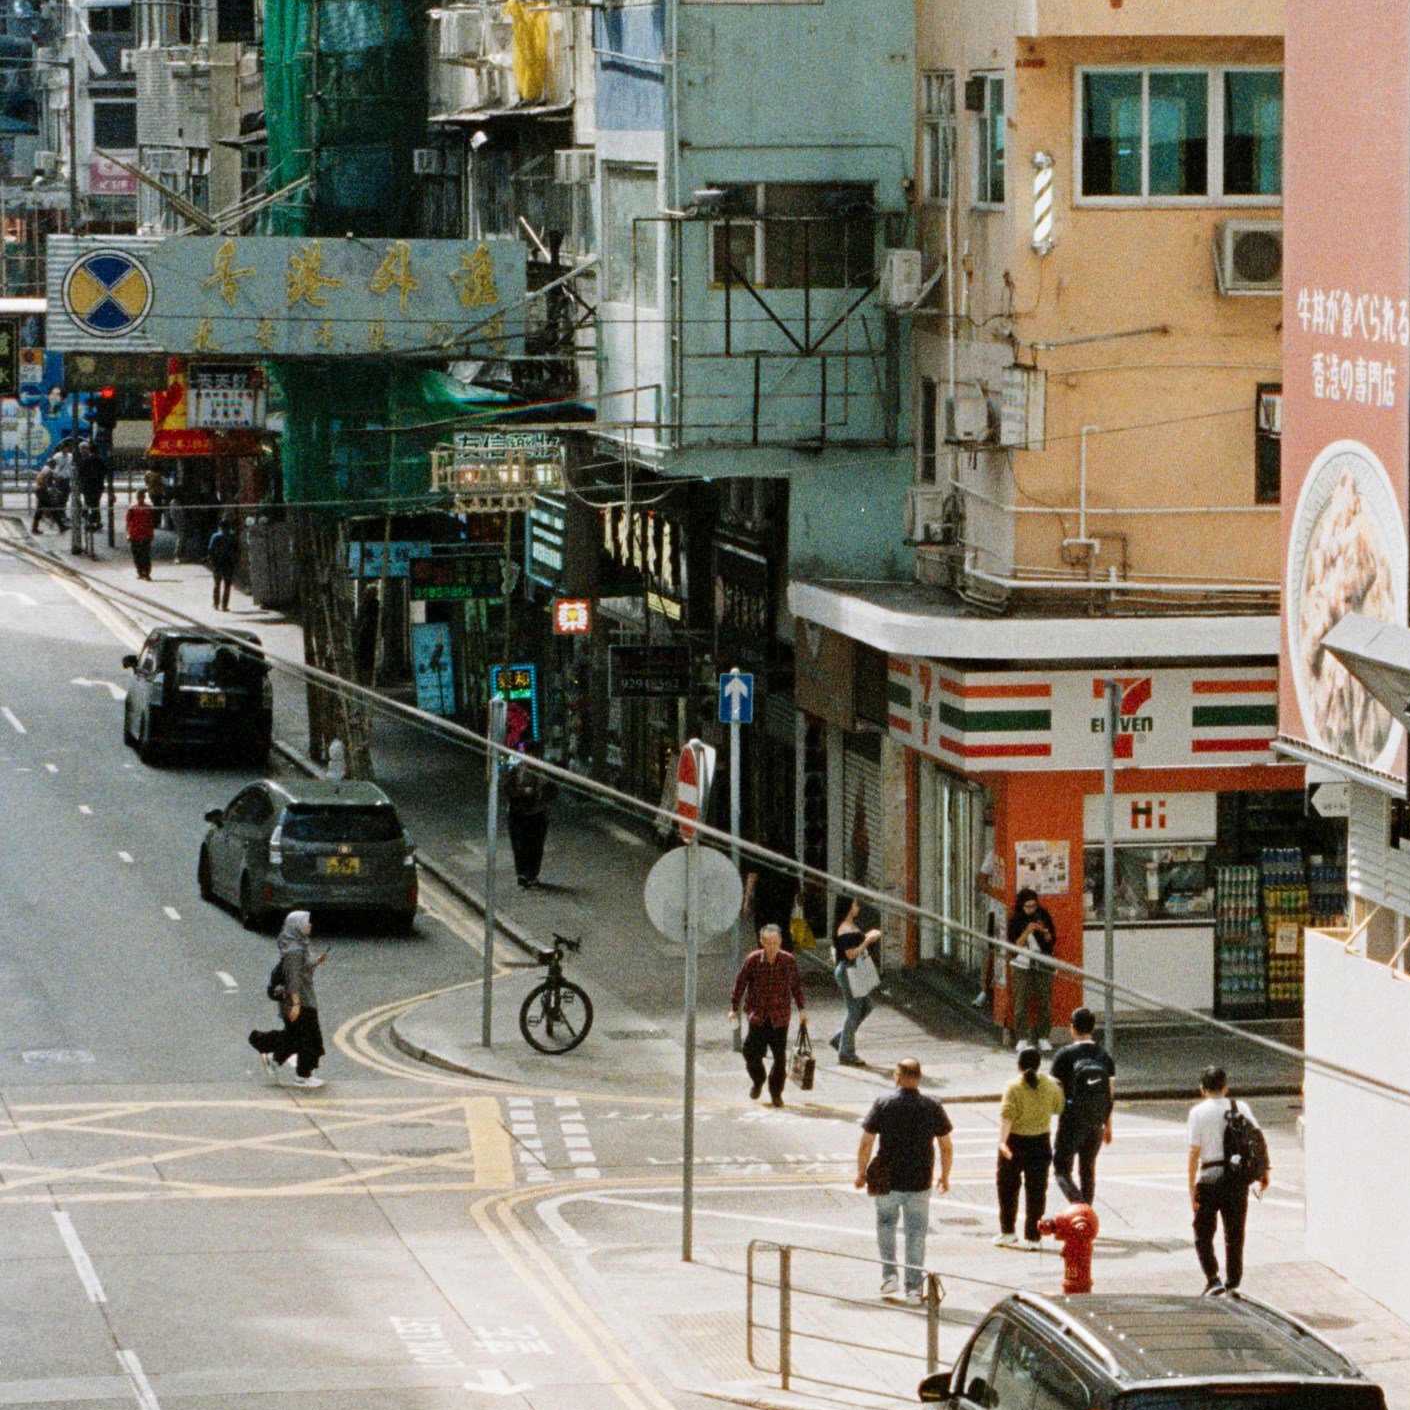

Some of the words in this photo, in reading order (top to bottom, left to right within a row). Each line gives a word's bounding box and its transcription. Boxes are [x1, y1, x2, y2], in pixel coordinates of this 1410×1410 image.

[1297, 288, 1409, 346] 牛丼が食べられる
[558, 602, 588, 631] 藥
